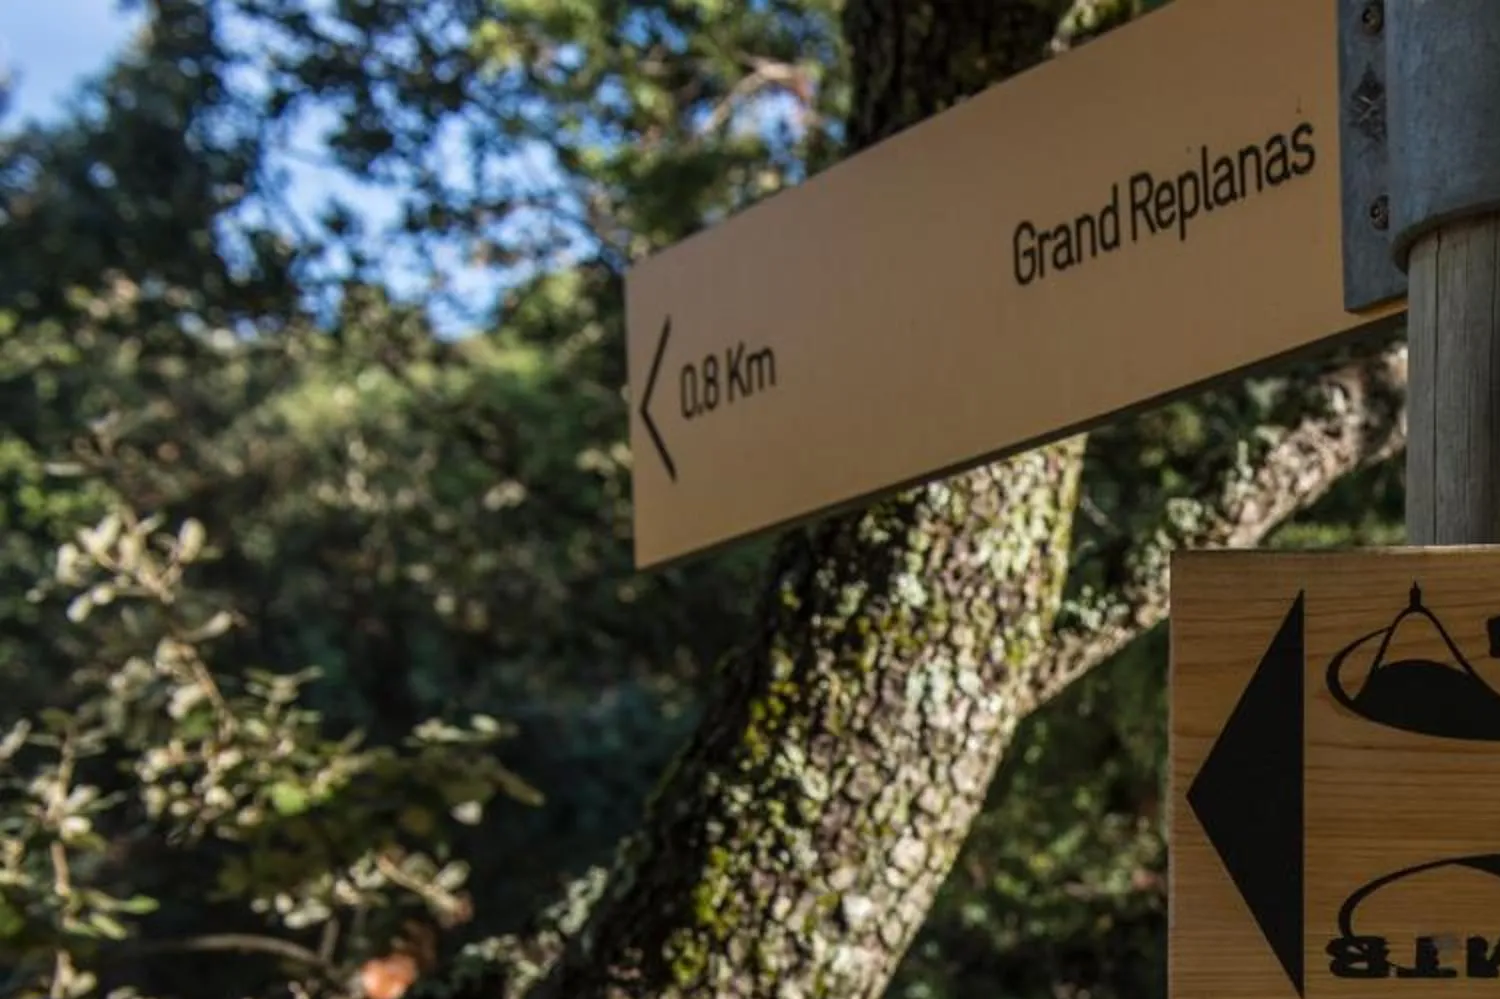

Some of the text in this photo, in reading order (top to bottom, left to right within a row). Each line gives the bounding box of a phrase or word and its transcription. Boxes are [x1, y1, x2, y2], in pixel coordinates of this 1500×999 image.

[1013, 122, 1316, 286] Grand Replanas
[726, 341, 777, 404] Km
